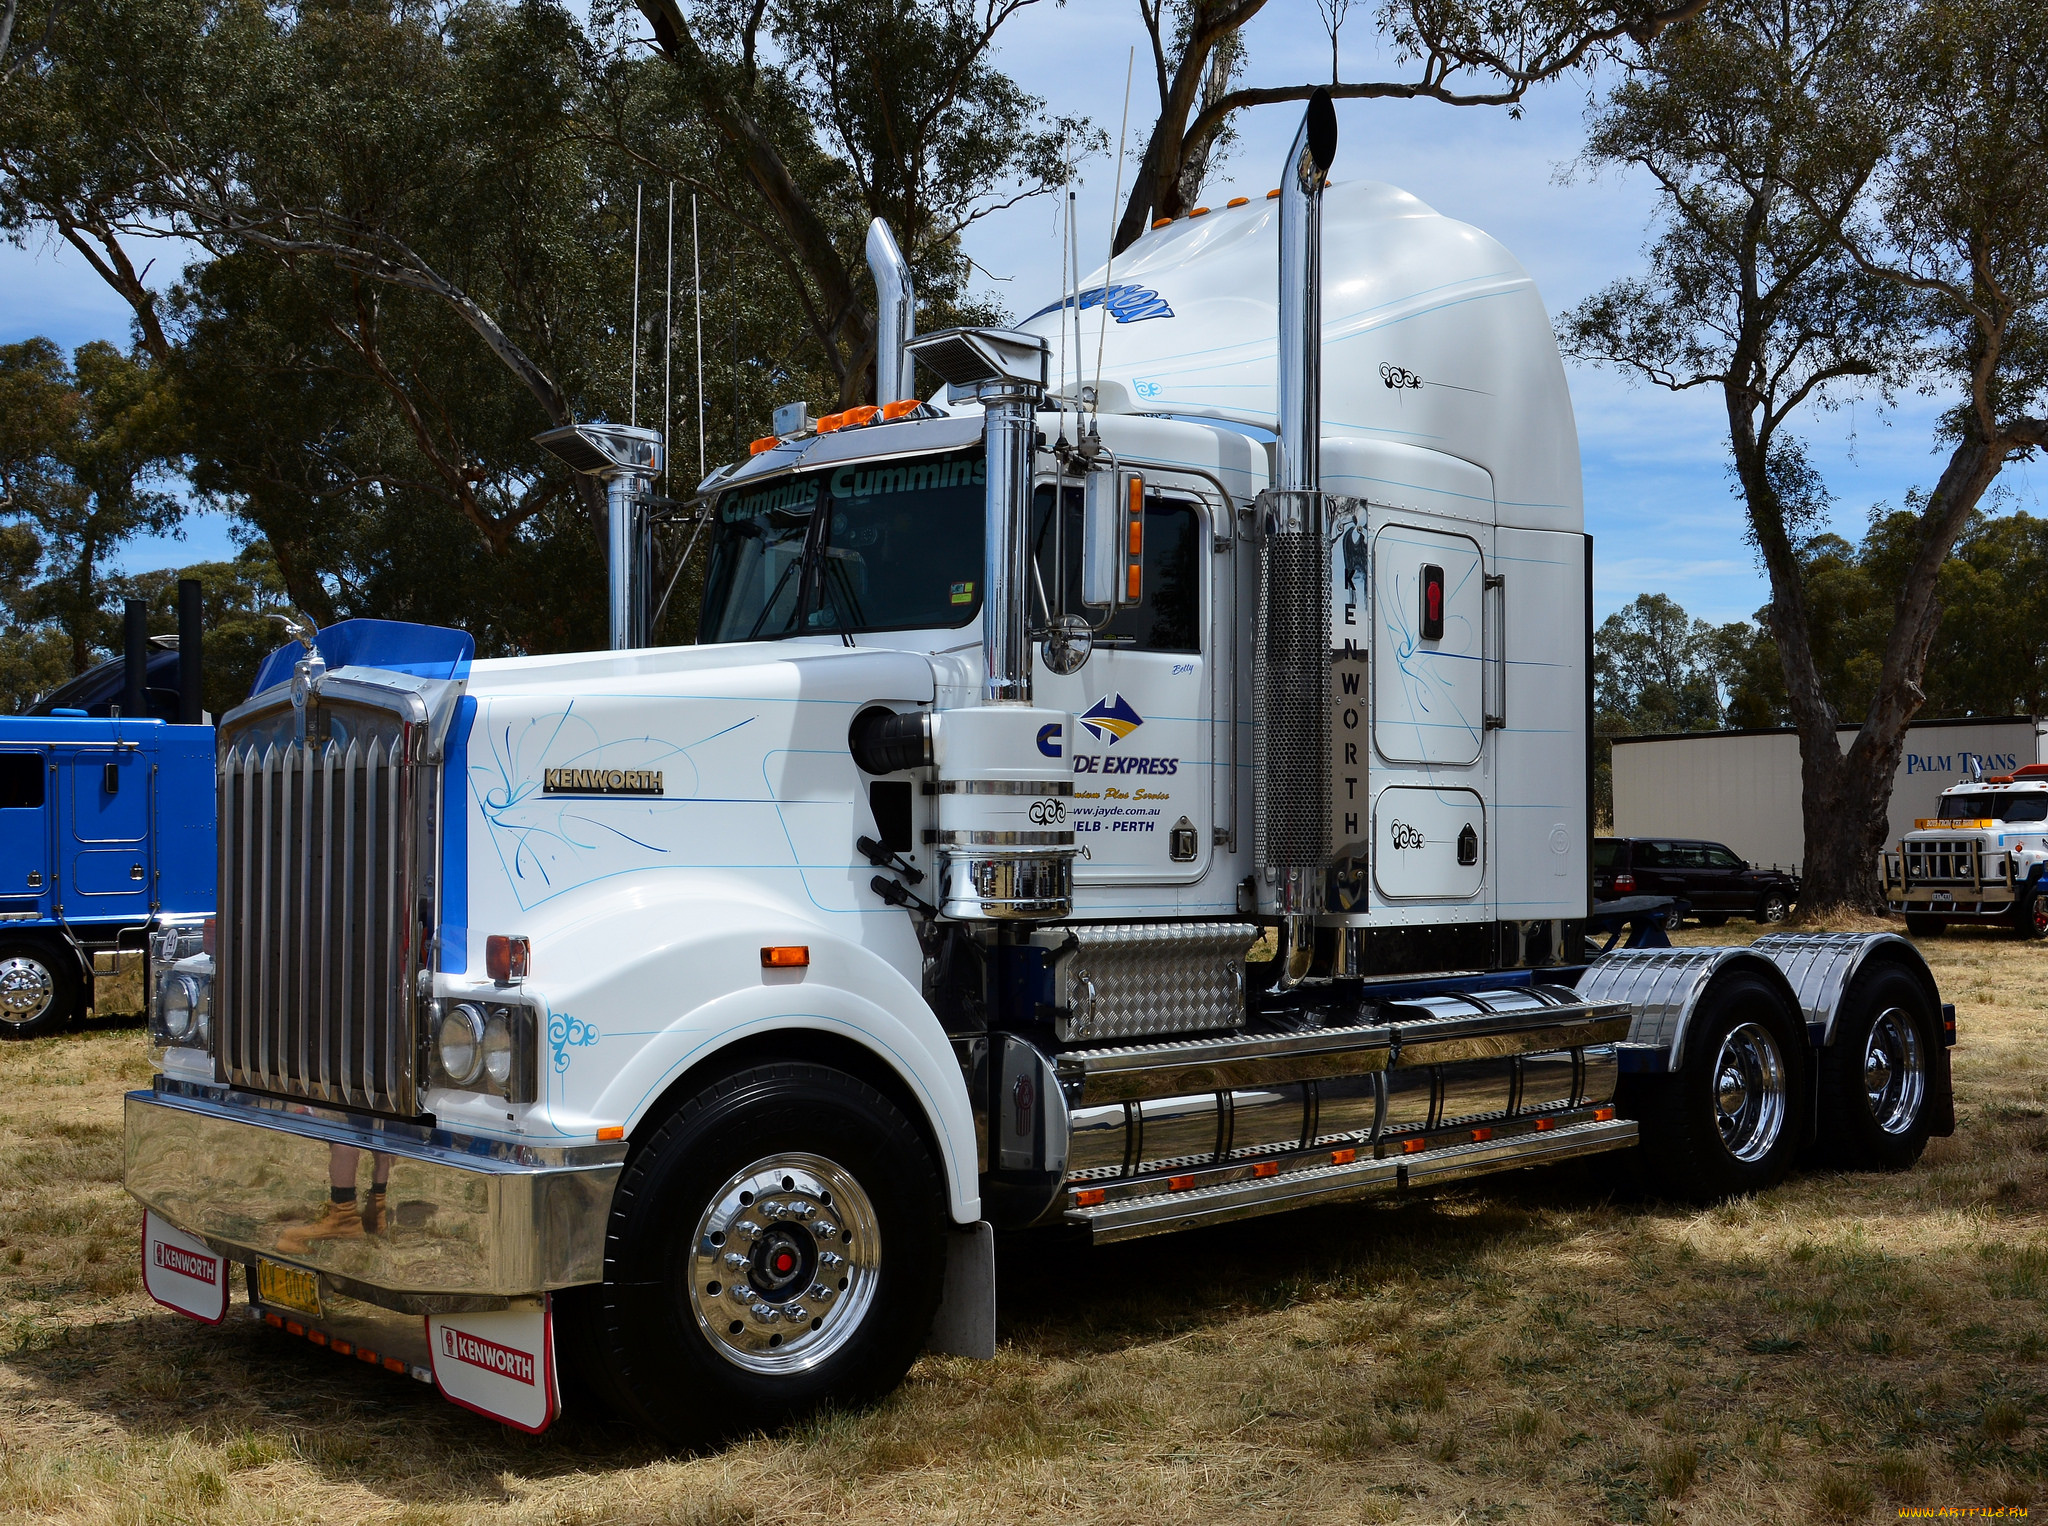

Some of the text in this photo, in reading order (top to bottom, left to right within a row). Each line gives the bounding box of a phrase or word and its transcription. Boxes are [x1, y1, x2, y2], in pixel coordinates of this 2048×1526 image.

[830, 454, 986, 499] Cummins
[722, 475, 820, 524] Cummins
[1341, 569, 1360, 835] KENWORTH
[1073, 755, 1178, 776] DE EXPRESS
[1906, 754, 1952, 774] PALM
[545, 768, 663, 789] KENWORTH
[1103, 787, 1130, 800] Plus
[1132, 788, 1170, 801] Service
[1112, 821, 1155, 832] PERTH
[165, 1247, 215, 1281] KENWORTH
[458, 1336, 533, 1381] KENWORTH
